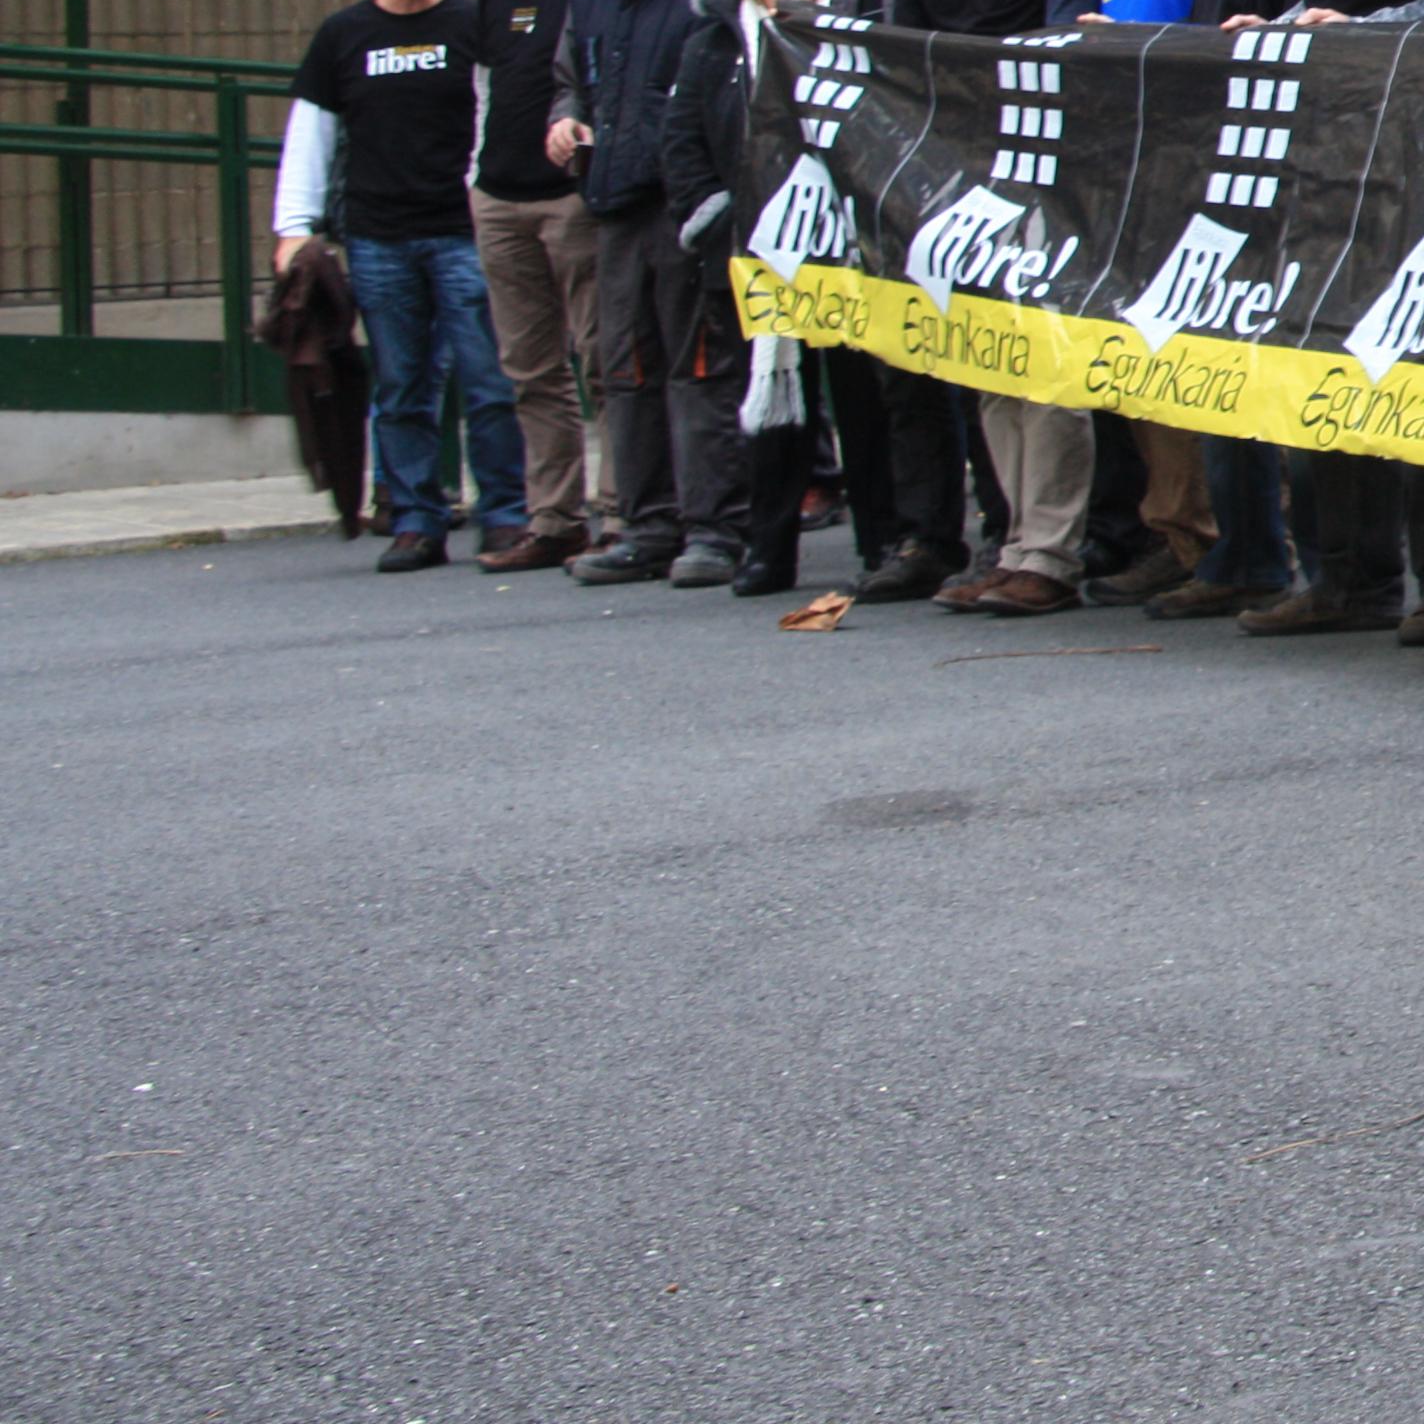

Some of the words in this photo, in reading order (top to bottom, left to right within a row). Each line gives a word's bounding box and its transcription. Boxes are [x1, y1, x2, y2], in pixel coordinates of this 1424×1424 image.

[366, 44, 447, 77] libre!
[929, 212, 1079, 298] libre!
[1153, 248, 1300, 334] libre!
[903, 297, 1030, 378] Egunkaria
[1086, 334, 1248, 414] Egunkaria
